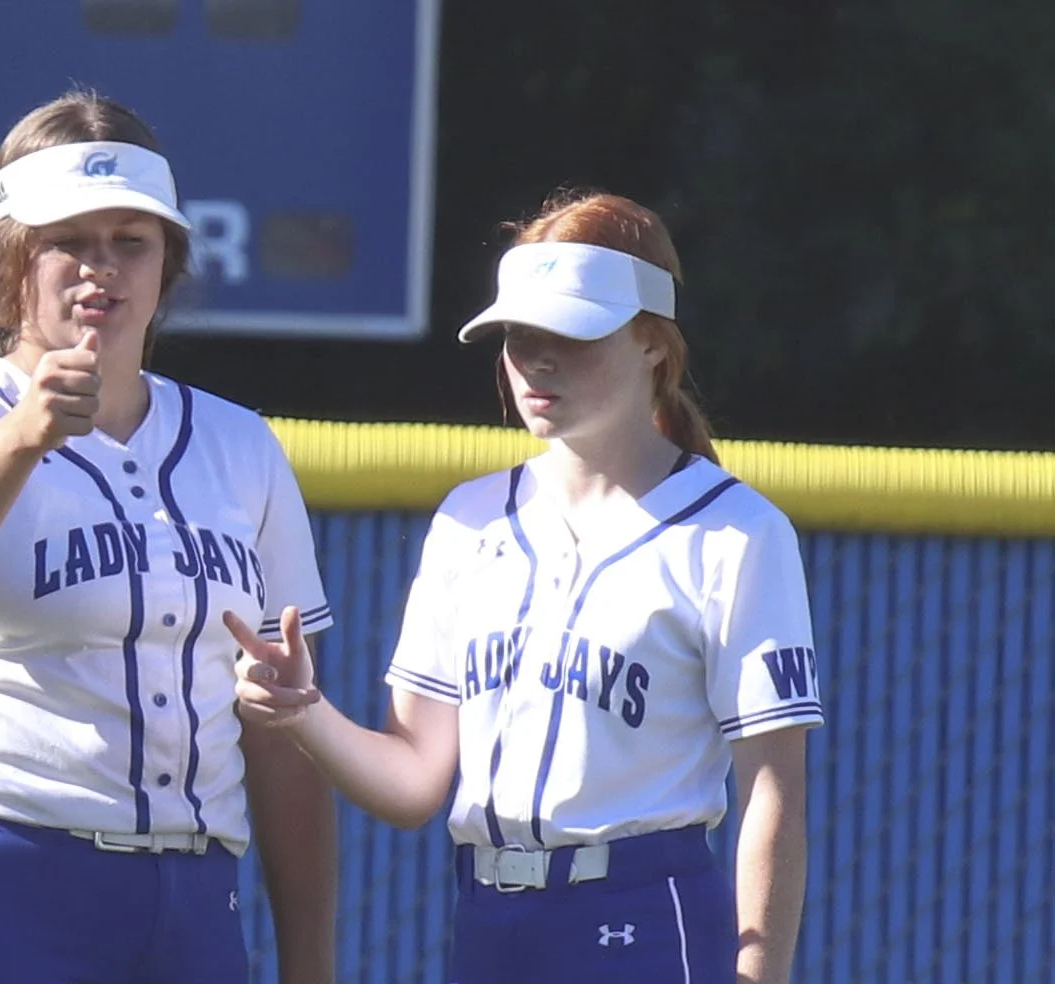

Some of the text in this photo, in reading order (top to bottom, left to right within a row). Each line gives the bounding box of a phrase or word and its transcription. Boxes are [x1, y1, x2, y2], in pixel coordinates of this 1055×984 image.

[34, 522, 265, 610] LADY JAYS
[465, 626, 650, 729] ADY JAYS
